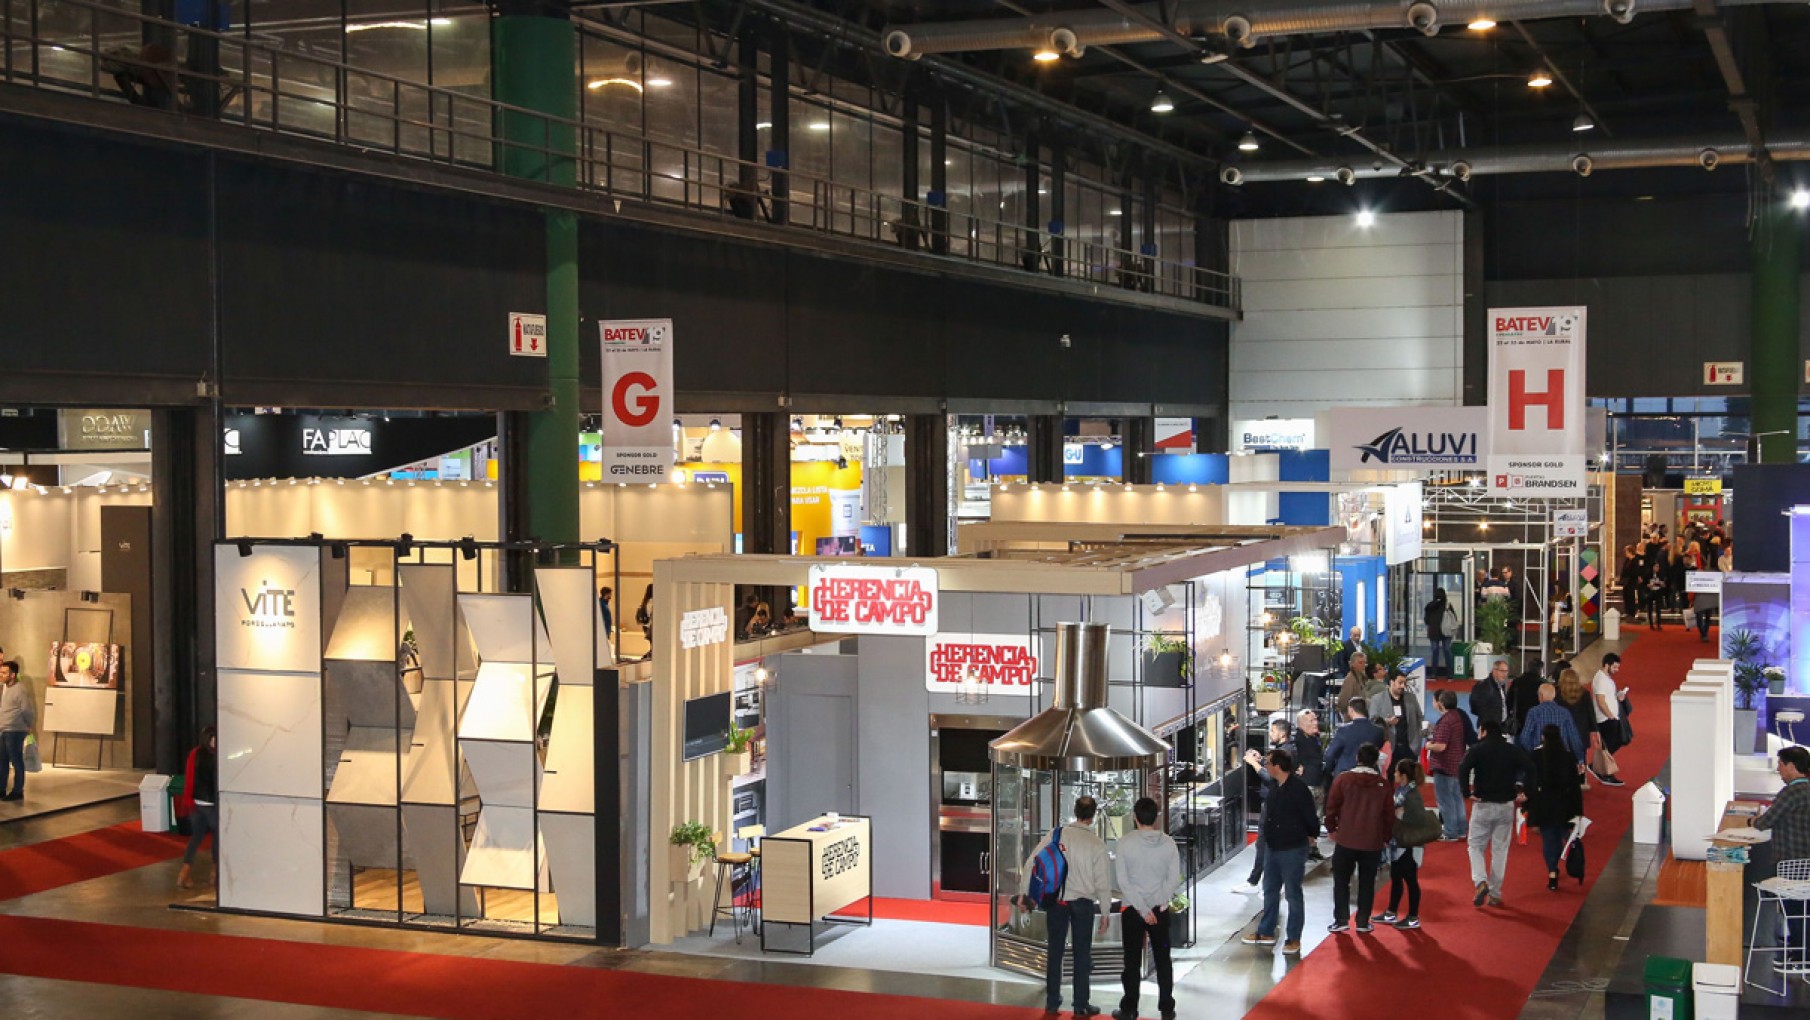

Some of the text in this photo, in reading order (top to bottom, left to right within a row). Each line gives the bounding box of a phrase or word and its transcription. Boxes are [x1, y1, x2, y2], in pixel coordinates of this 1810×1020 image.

[612, 371, 660, 427] G
[1508, 369, 1564, 430] H
[303, 428, 371, 449] FAPLAC
[1391, 432, 1476, 454] ALUVI
[610, 465, 664, 475] GENEBRE
[1391, 455, 1458, 463] CONSTRUCCIONES
[1525, 480, 1577, 488] BRANDSEN
[814, 578, 932, 602] HERENCIA
[820, 600, 925, 624] DE CAMPO
[930, 643, 1036, 665] HERENCIA
[936, 664, 962, 682] DE
